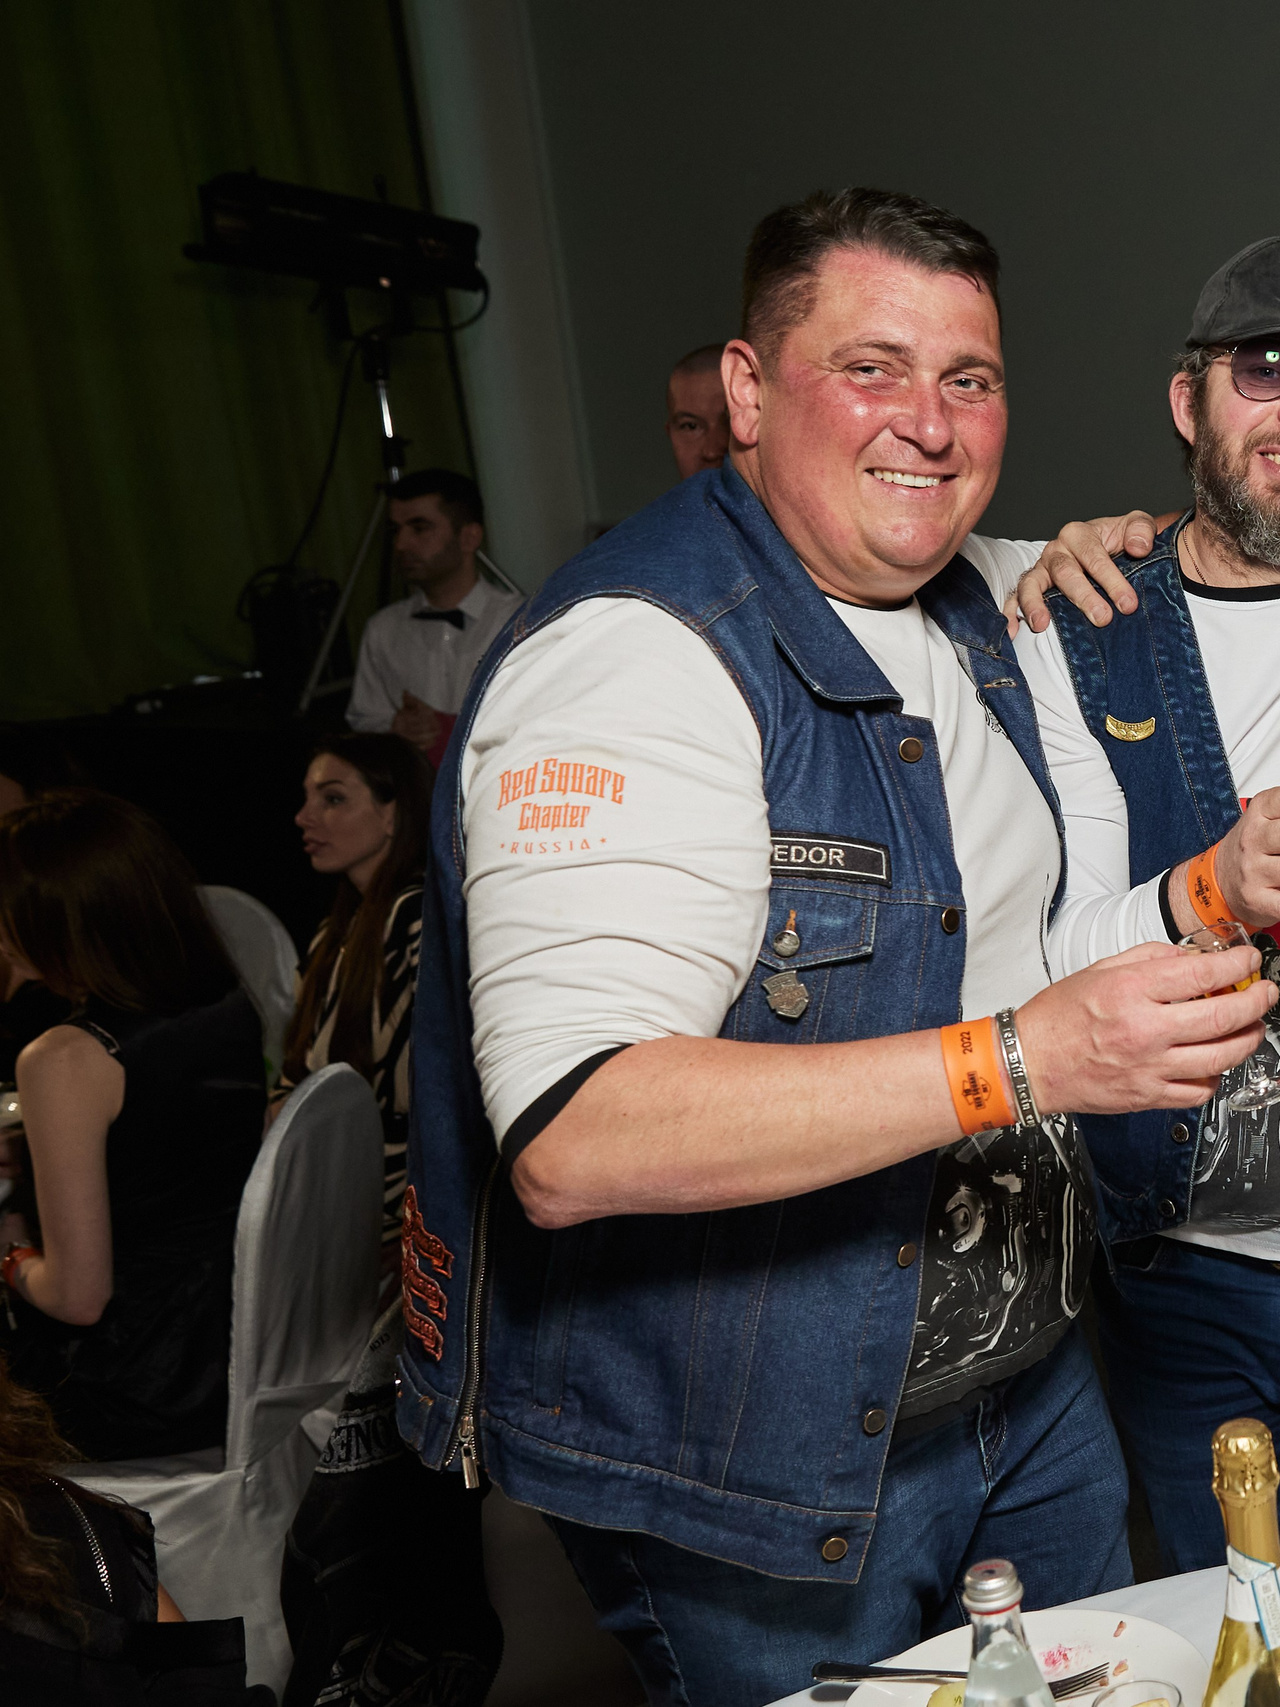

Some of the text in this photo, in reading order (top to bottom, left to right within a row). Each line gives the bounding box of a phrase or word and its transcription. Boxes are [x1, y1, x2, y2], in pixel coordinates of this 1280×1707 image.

[497, 758, 626, 811] Red Square
[518, 802, 591, 833] Chapter
[510, 839, 591, 854] RUSSIA
[773, 844, 846, 867] EDOR
[960, 1031, 973, 1055] 2022
[968, 1073, 980, 1096] SQUARE
